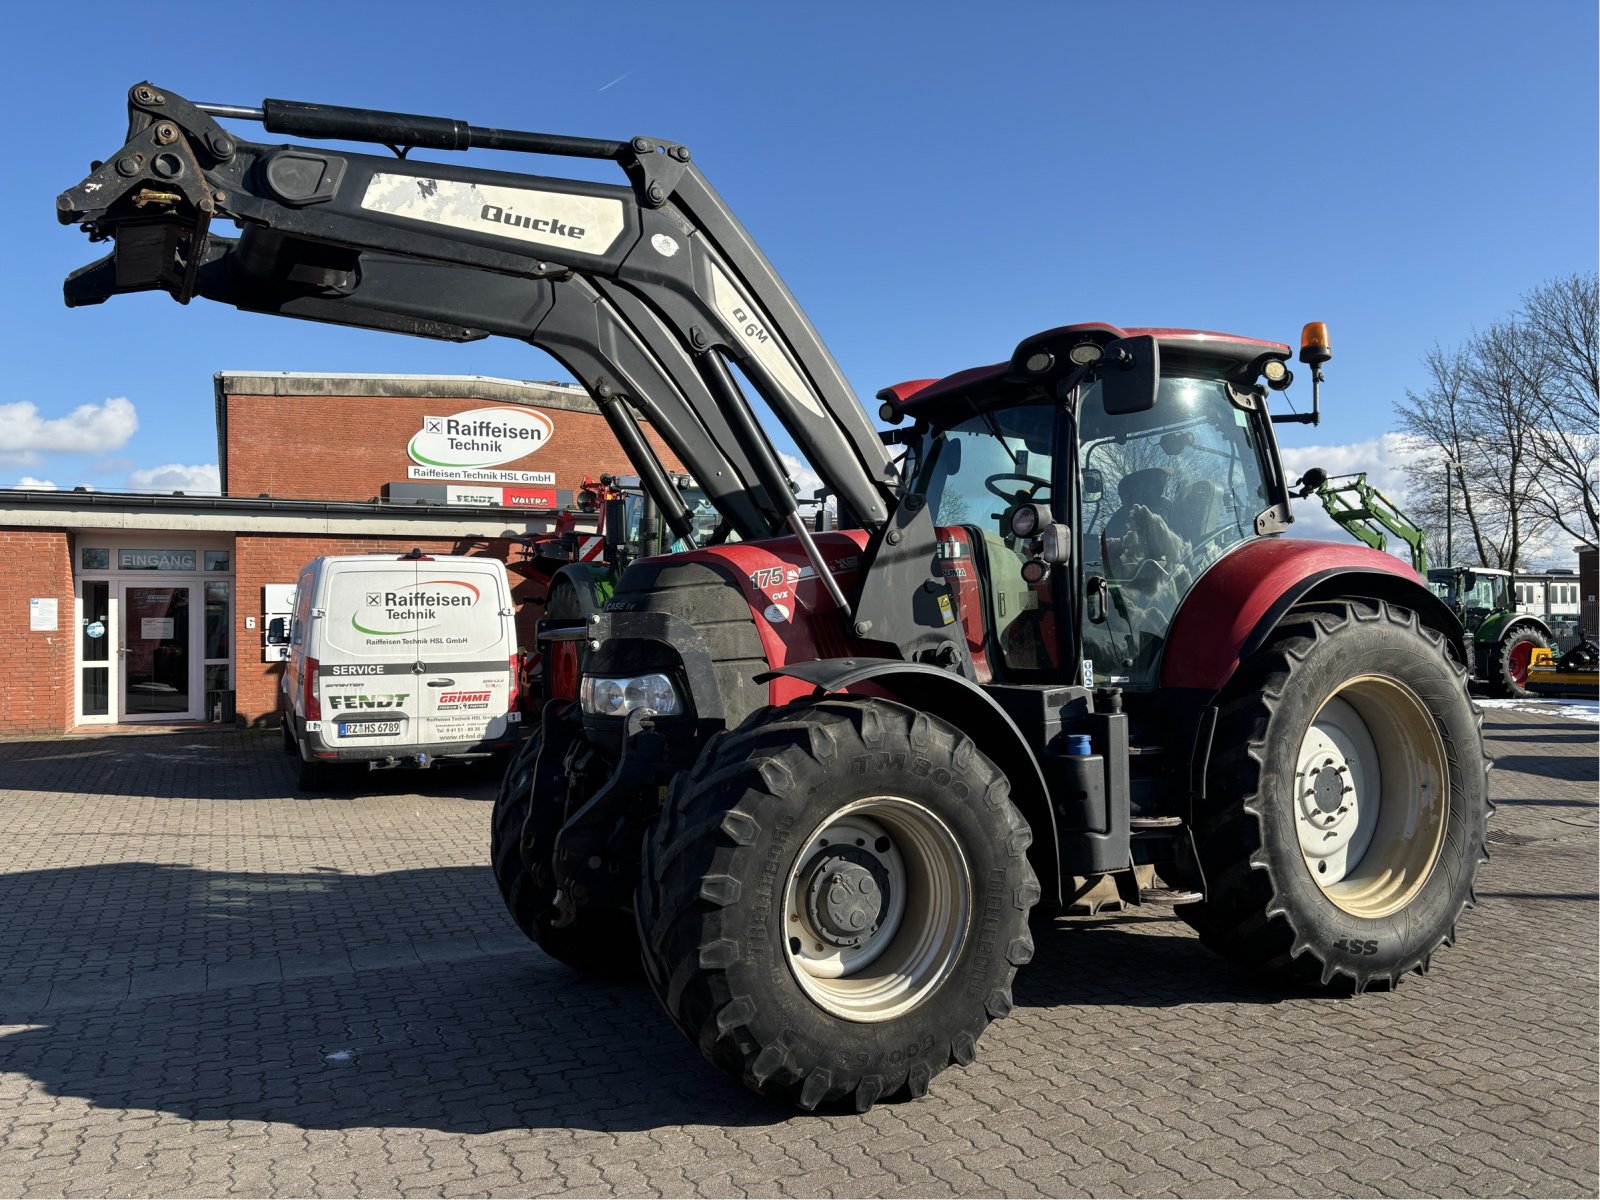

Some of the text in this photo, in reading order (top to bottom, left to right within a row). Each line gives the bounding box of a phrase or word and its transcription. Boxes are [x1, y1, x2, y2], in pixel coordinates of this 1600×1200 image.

[480, 204, 585, 240] Quicke
[447, 419, 542, 441] Raiffeisen
[447, 437, 503, 453] Technik
[413, 468, 551, 483] Raiffeisen Technik HSL GmbH
[456, 494, 494, 504] FENDT
[511, 496, 548, 506] VALTRA
[121, 554, 193, 567] EINGANG
[749, 565, 784, 590] 175
[942, 567, 967, 577] PUMA
[385, 592, 471, 607] Raiffeisen
[772, 590, 788, 600] CVX
[385, 609, 436, 620] Technik
[246, 616, 256, 629] 6
[366, 638, 401, 646] Raiffeisen
[332, 665, 384, 675] SERVICE
[328, 693, 410, 710] FENDT
[439, 691, 491, 703] GRIMME
[346, 722, 399, 734] RZ HS 6789
[1332, 938, 1379, 956] SST
